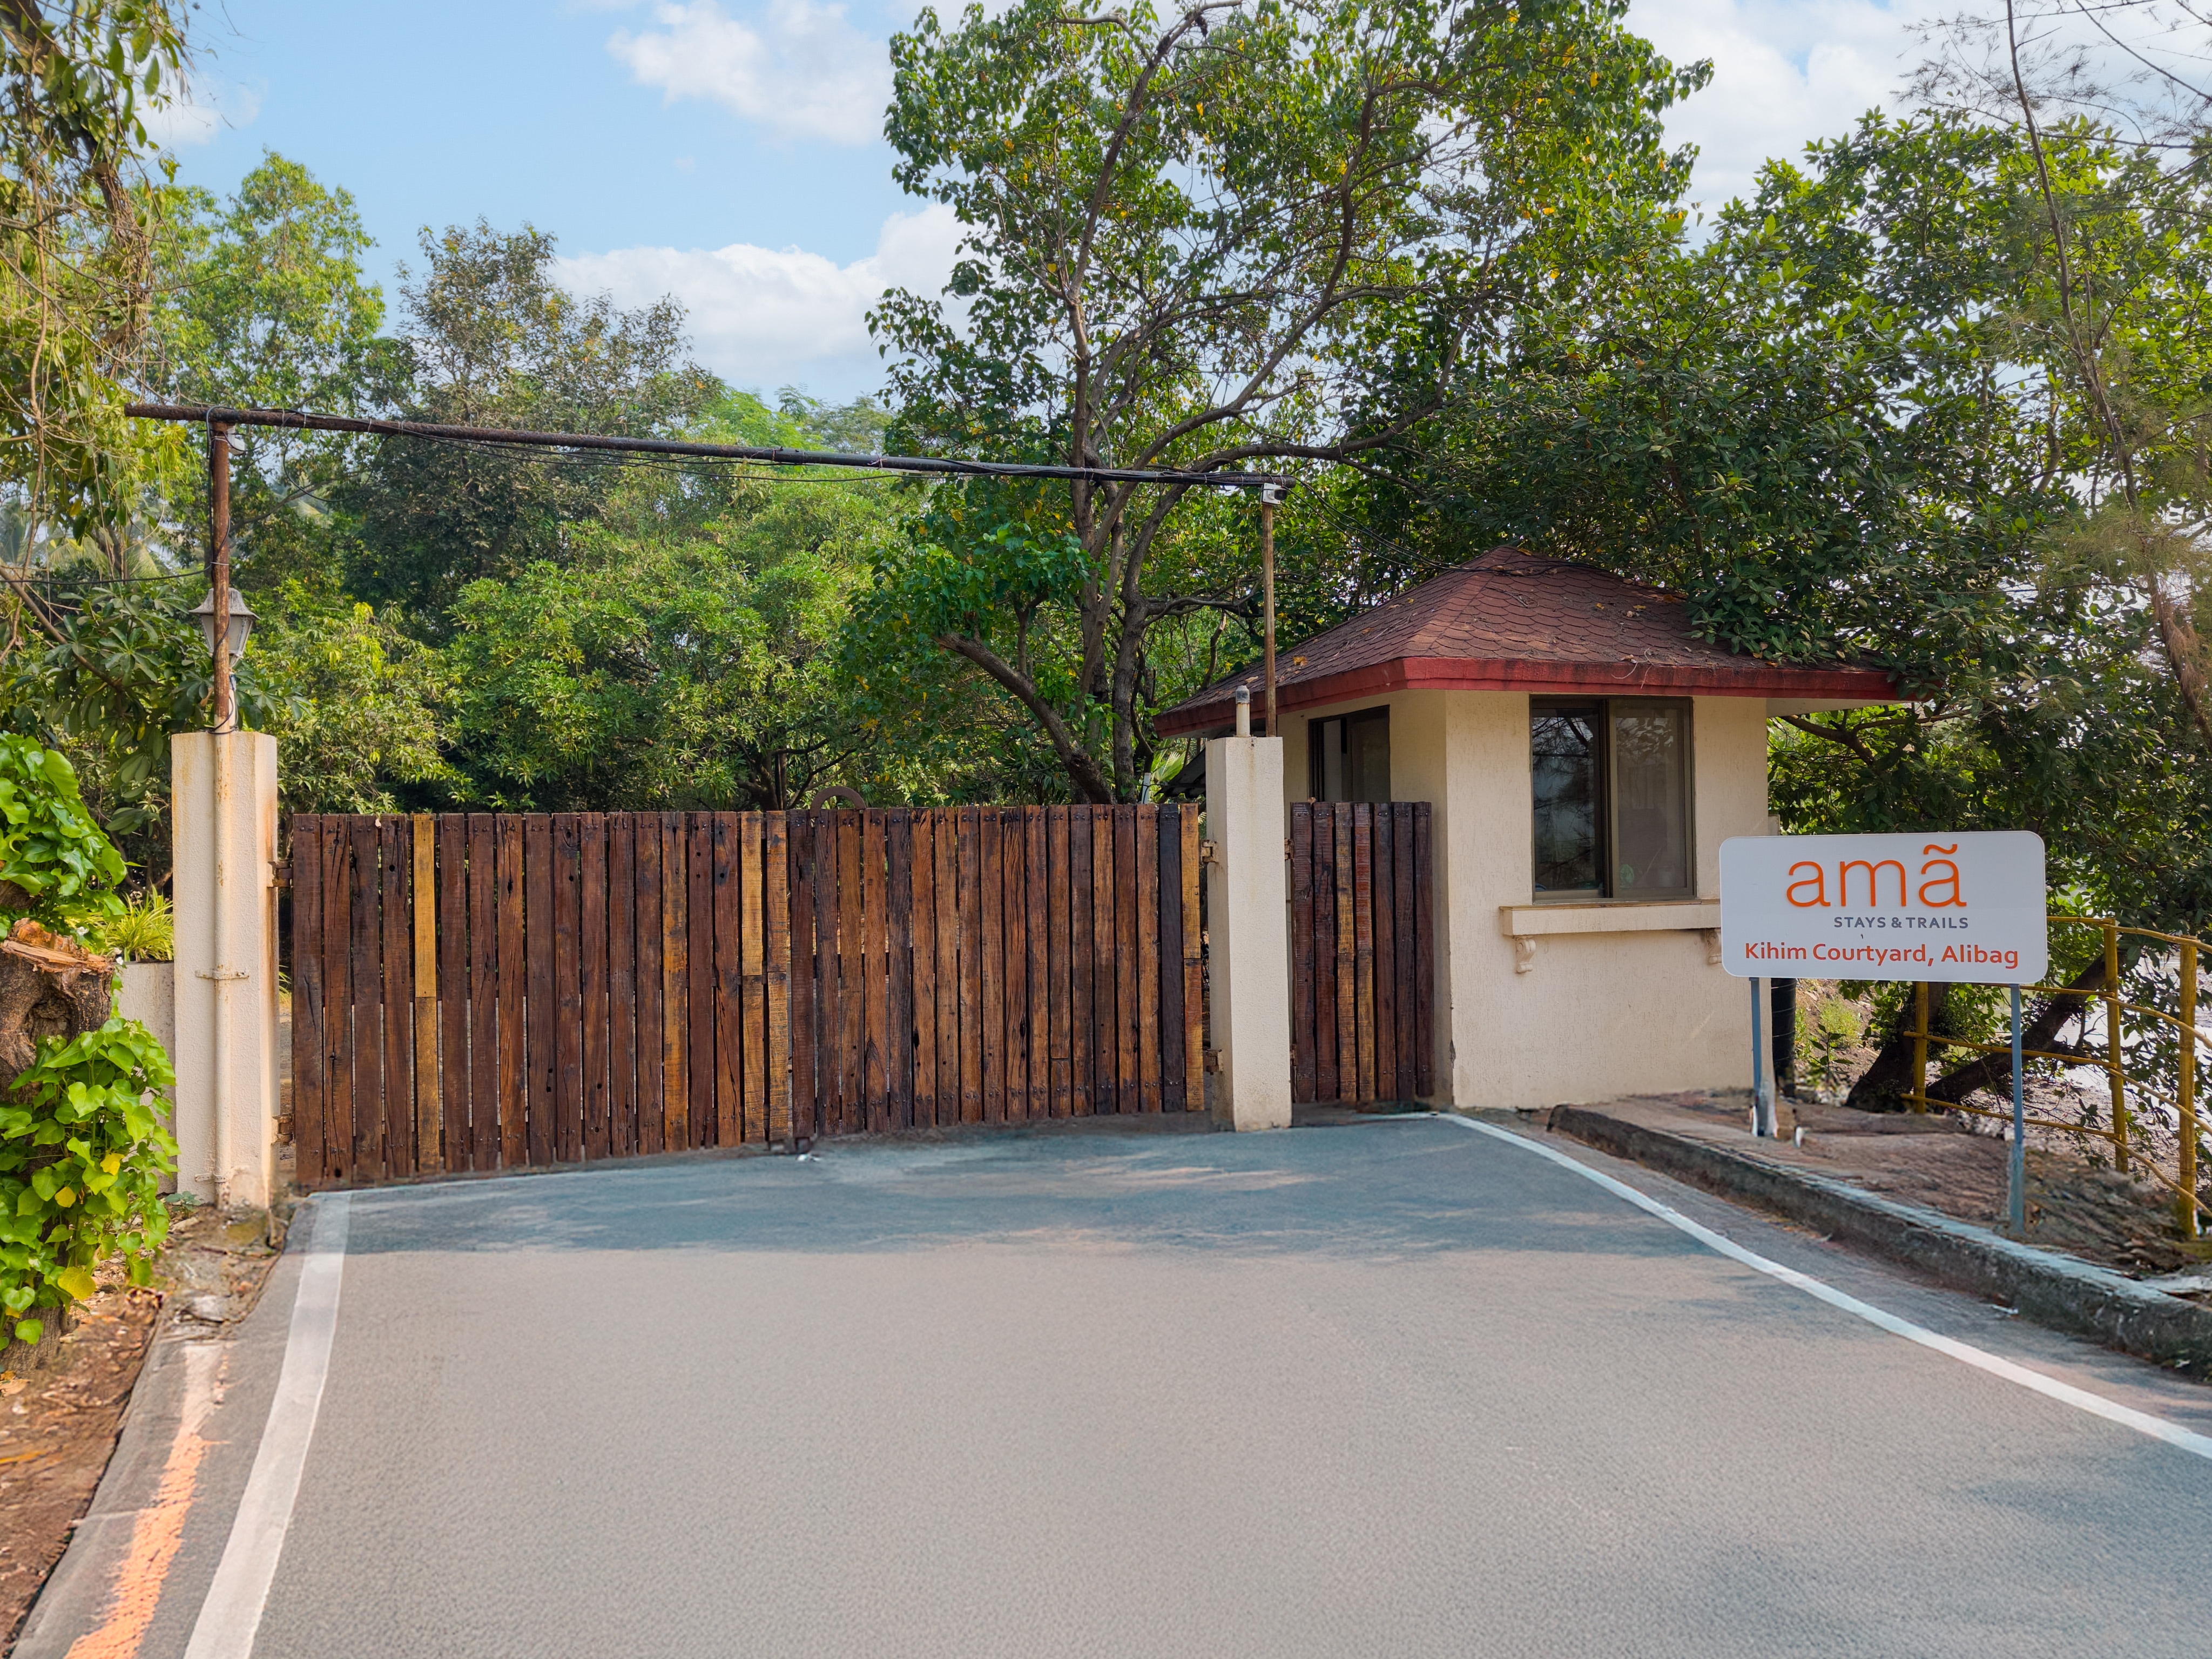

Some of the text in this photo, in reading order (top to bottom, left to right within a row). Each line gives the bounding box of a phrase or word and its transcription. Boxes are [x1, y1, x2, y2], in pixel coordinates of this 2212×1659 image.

[1786, 844, 1967, 908] amã
[1834, 916, 1968, 929] STAYS & TRAILS
[1745, 942, 2019, 969] Kihim Courtyard, Alibag
